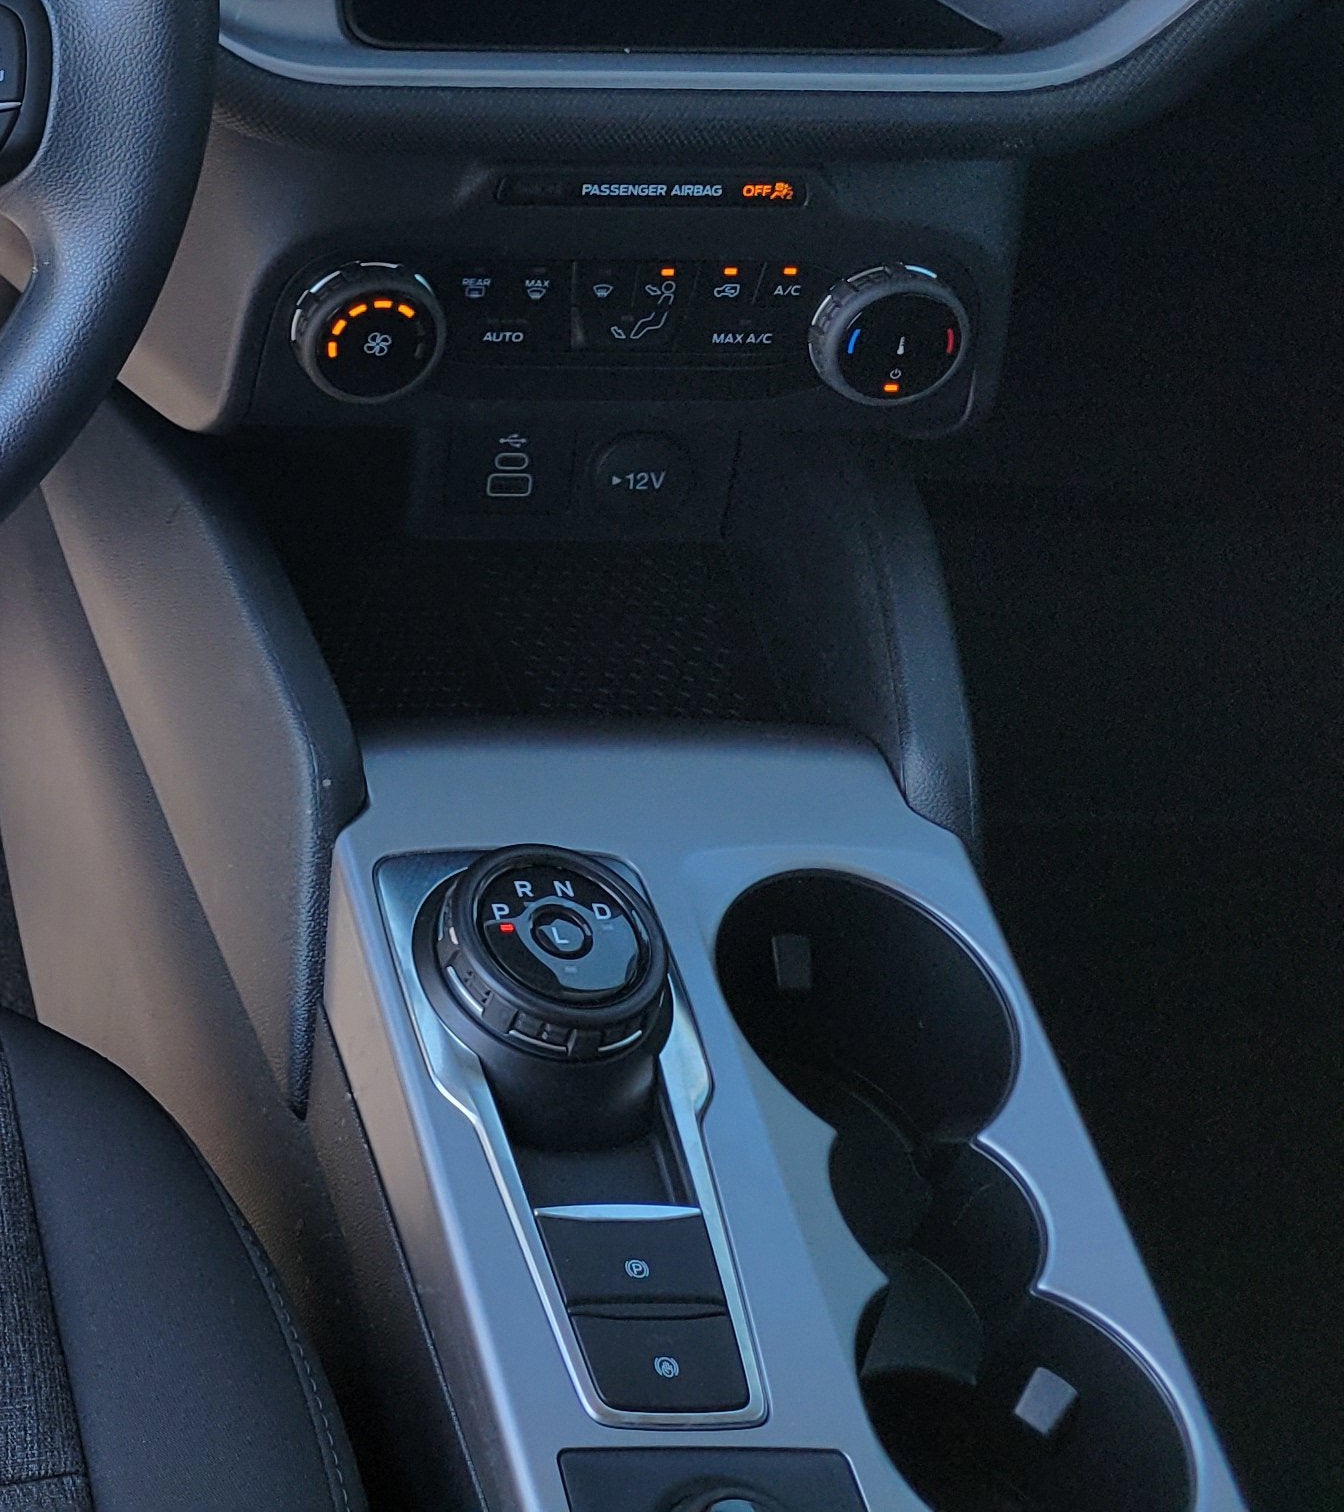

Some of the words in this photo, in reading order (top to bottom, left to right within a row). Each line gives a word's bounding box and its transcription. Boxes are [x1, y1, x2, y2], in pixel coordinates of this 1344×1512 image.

[581, 183, 667, 197] PASSENGER
[670, 184, 723, 197] AIRBAG
[742, 184, 772, 197] OFF
[461, 278, 491, 286] REAR
[524, 278, 550, 287] MAX
[773, 285, 801, 296] A/C
[482, 331, 524, 343] AUTO
[711, 333, 744, 344] MAX
[745, 333, 773, 344] A/C
[624, 471, 666, 490] 12V
[514, 879, 533, 899] R
[553, 879, 575, 899] N
[491, 903, 511, 921] P
[592, 902, 613, 921] D
[553, 926, 570, 946] L
